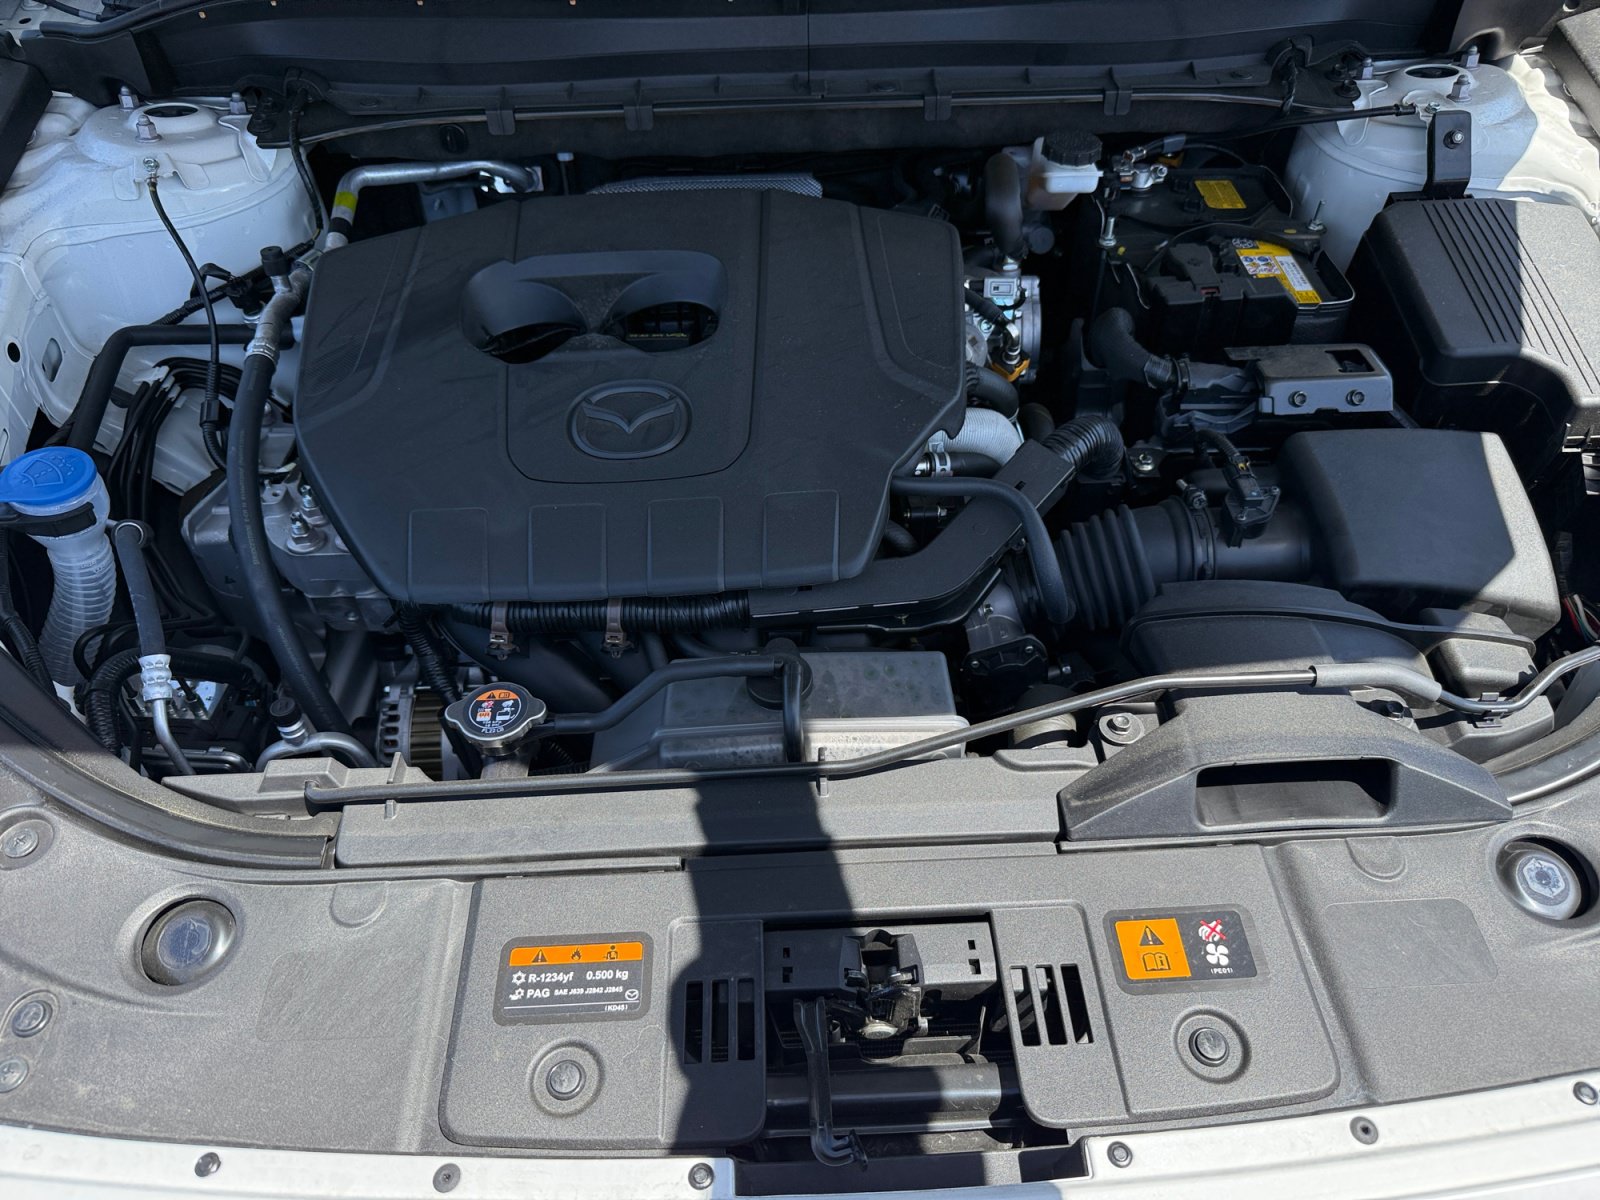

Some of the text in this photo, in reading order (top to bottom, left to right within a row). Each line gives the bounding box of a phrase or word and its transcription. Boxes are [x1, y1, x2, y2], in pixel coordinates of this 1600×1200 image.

[528, 969, 629, 984] R-1234yf 0.500 kg
[527, 988, 551, 999] PAG
